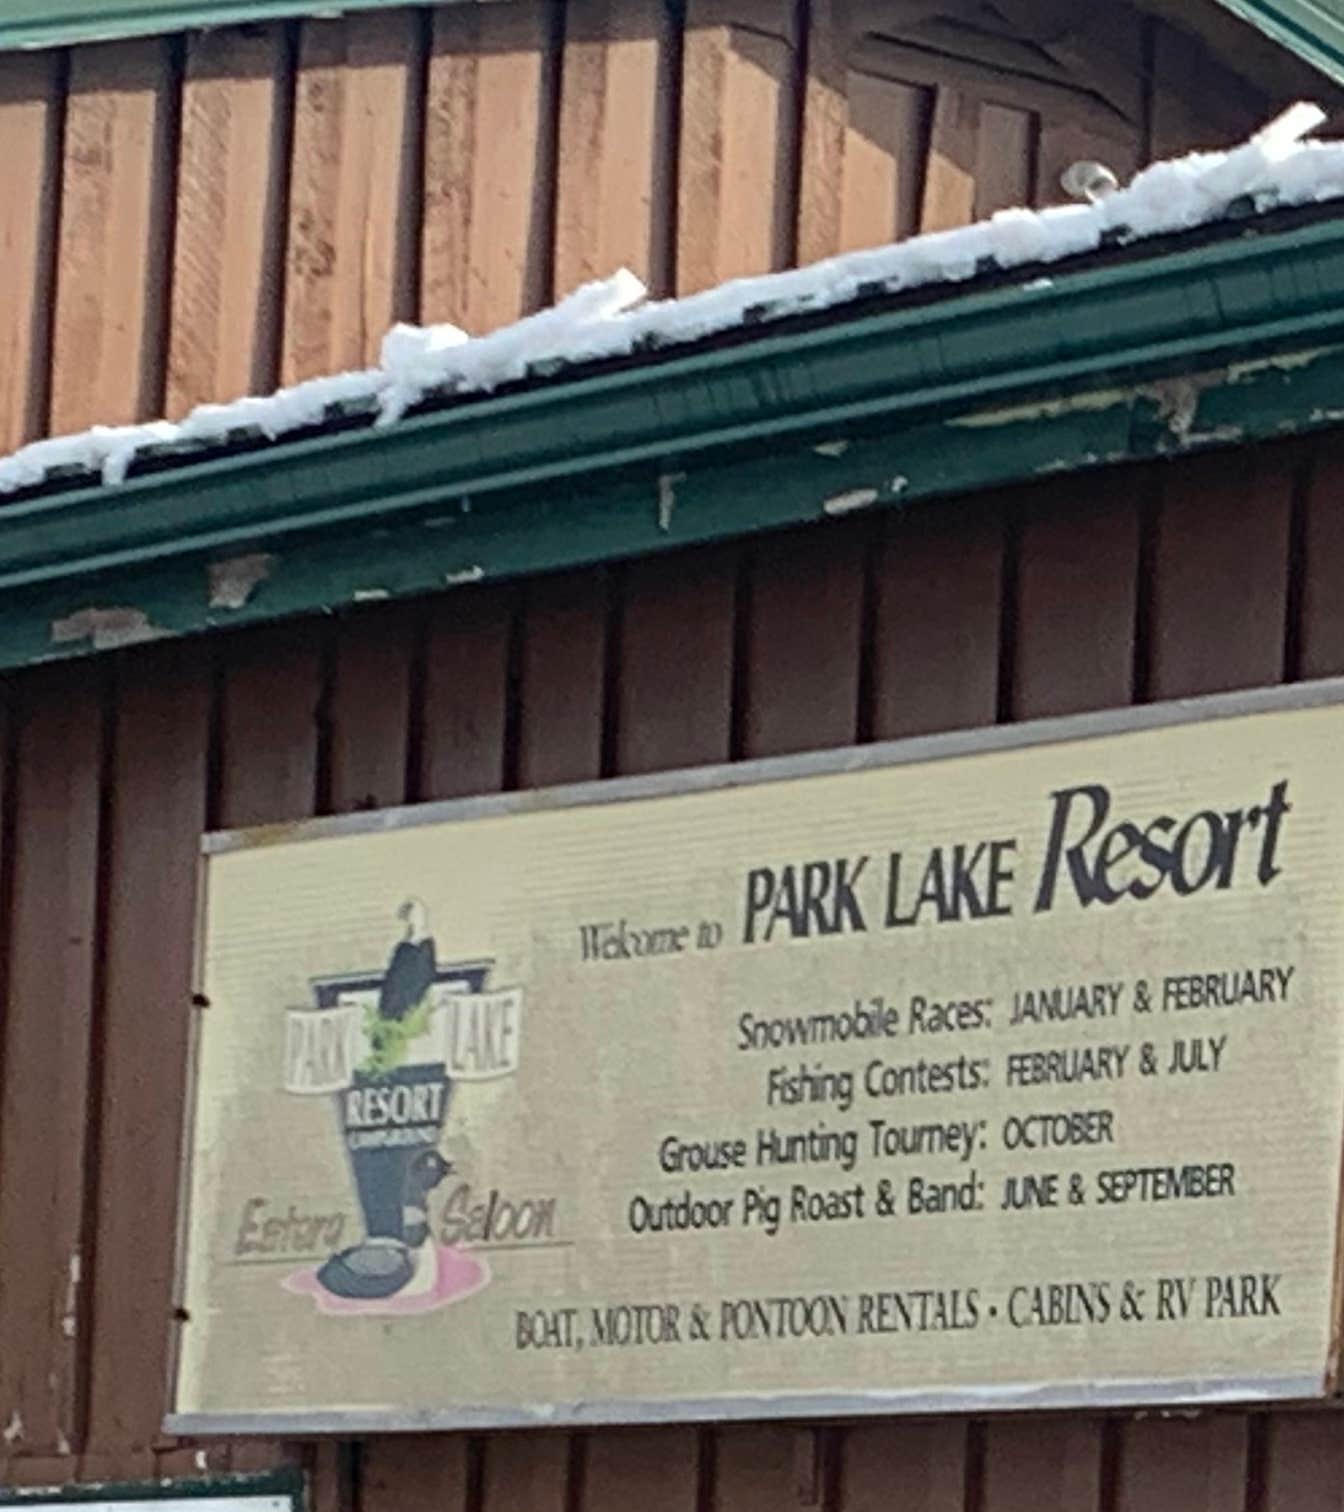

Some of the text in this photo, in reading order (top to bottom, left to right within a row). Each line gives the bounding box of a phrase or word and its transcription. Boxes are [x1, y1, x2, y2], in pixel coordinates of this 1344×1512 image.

[579, 780, 1290, 961] Welcome to PARK LAKE Resort
[739, 965, 1295, 1050] Snowmobile Races: JANUARY & FEBRUARY
[346, 1083, 444, 1127] RESORT
[768, 1035, 1227, 1113] Fishing Contests: FEBRUARY & JULY
[659, 1110, 1114, 1173] Grouse Hunting Tourney: OCTOBER
[630, 1163, 1235, 1237] Outdoor Pig Roast & Band: JUNE & SEPTEMBER
[515, 1272, 1283, 1352] BOAT, MOTOR & PONTOON RENTALS CABINS & RV PARK
